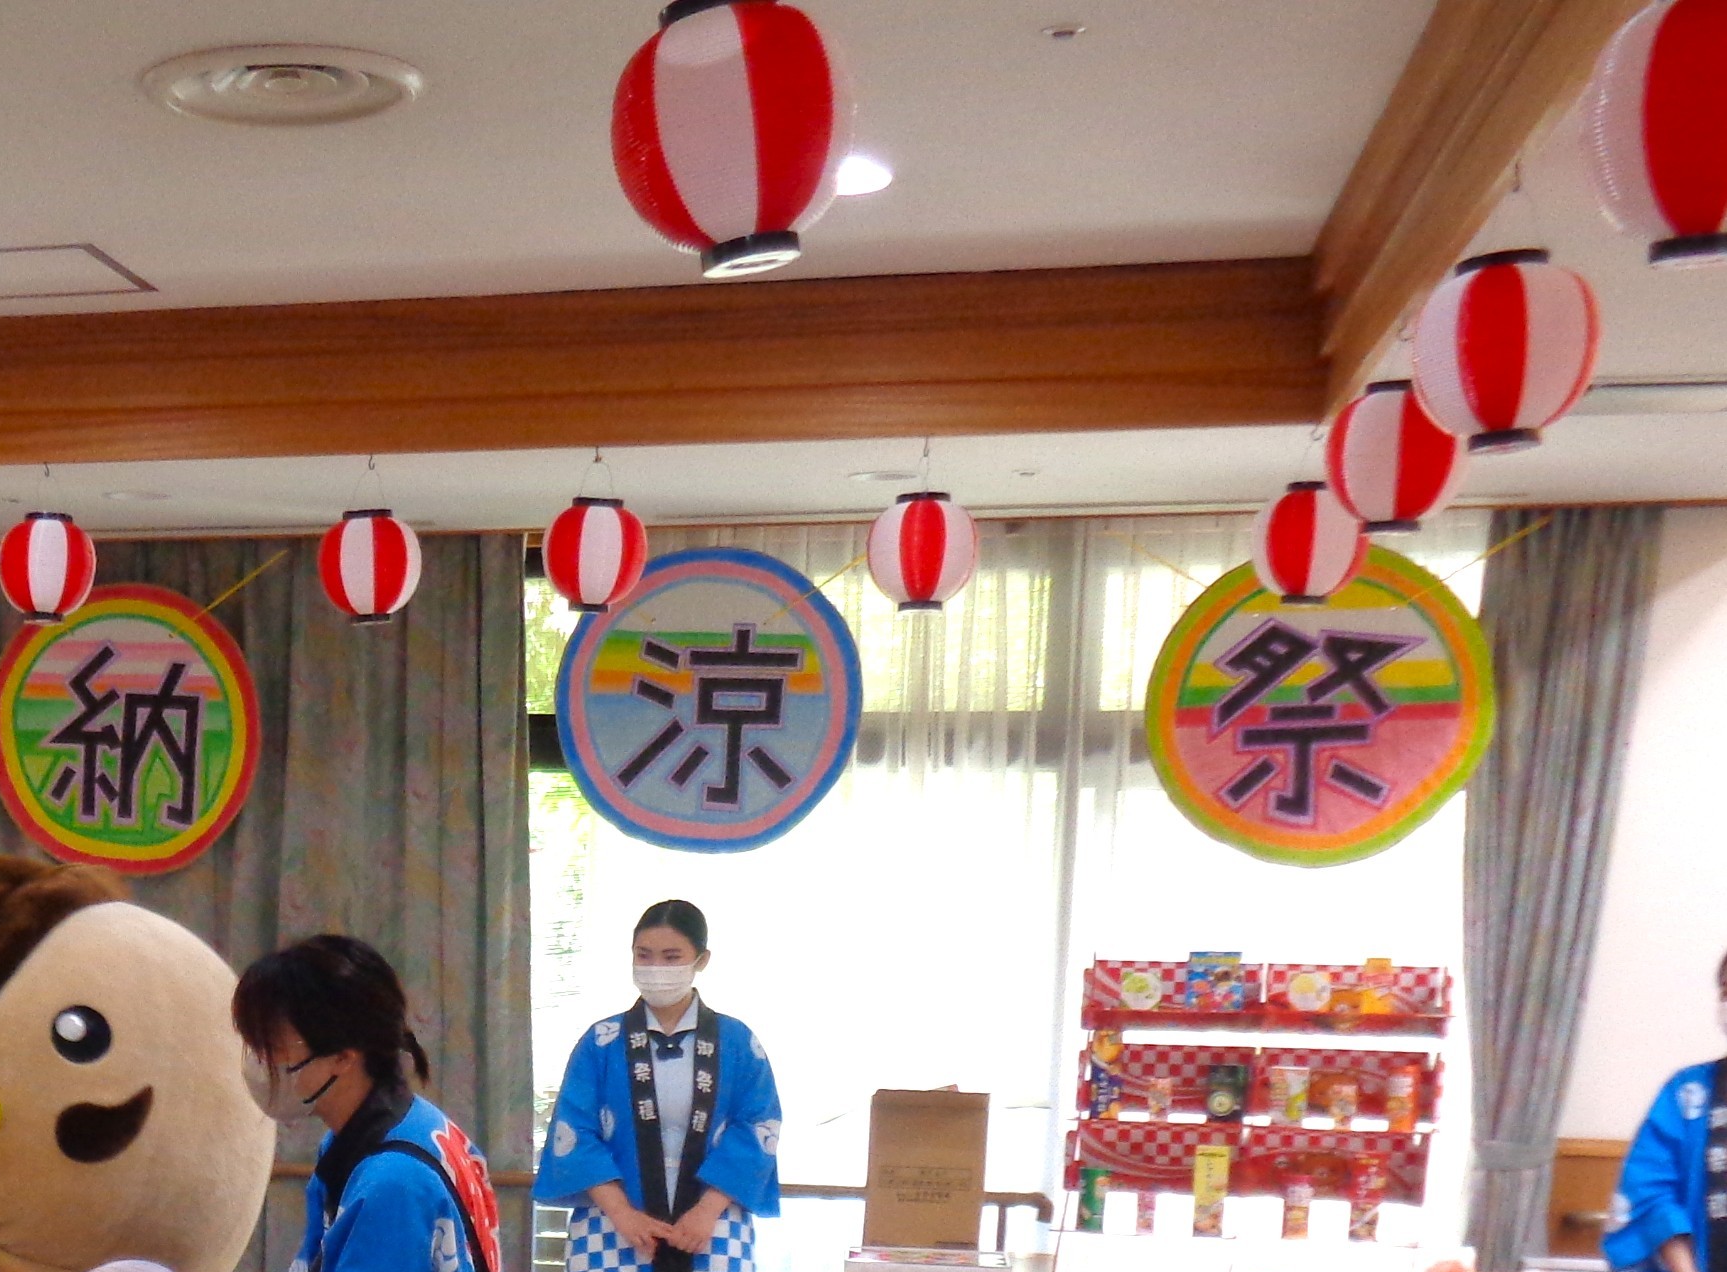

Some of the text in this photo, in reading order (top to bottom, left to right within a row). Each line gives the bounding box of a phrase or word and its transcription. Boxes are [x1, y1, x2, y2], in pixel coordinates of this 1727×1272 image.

[48, 644, 202, 826] 納
[614, 626, 802, 806] 涼
[1215, 622, 1414, 818] 祭
